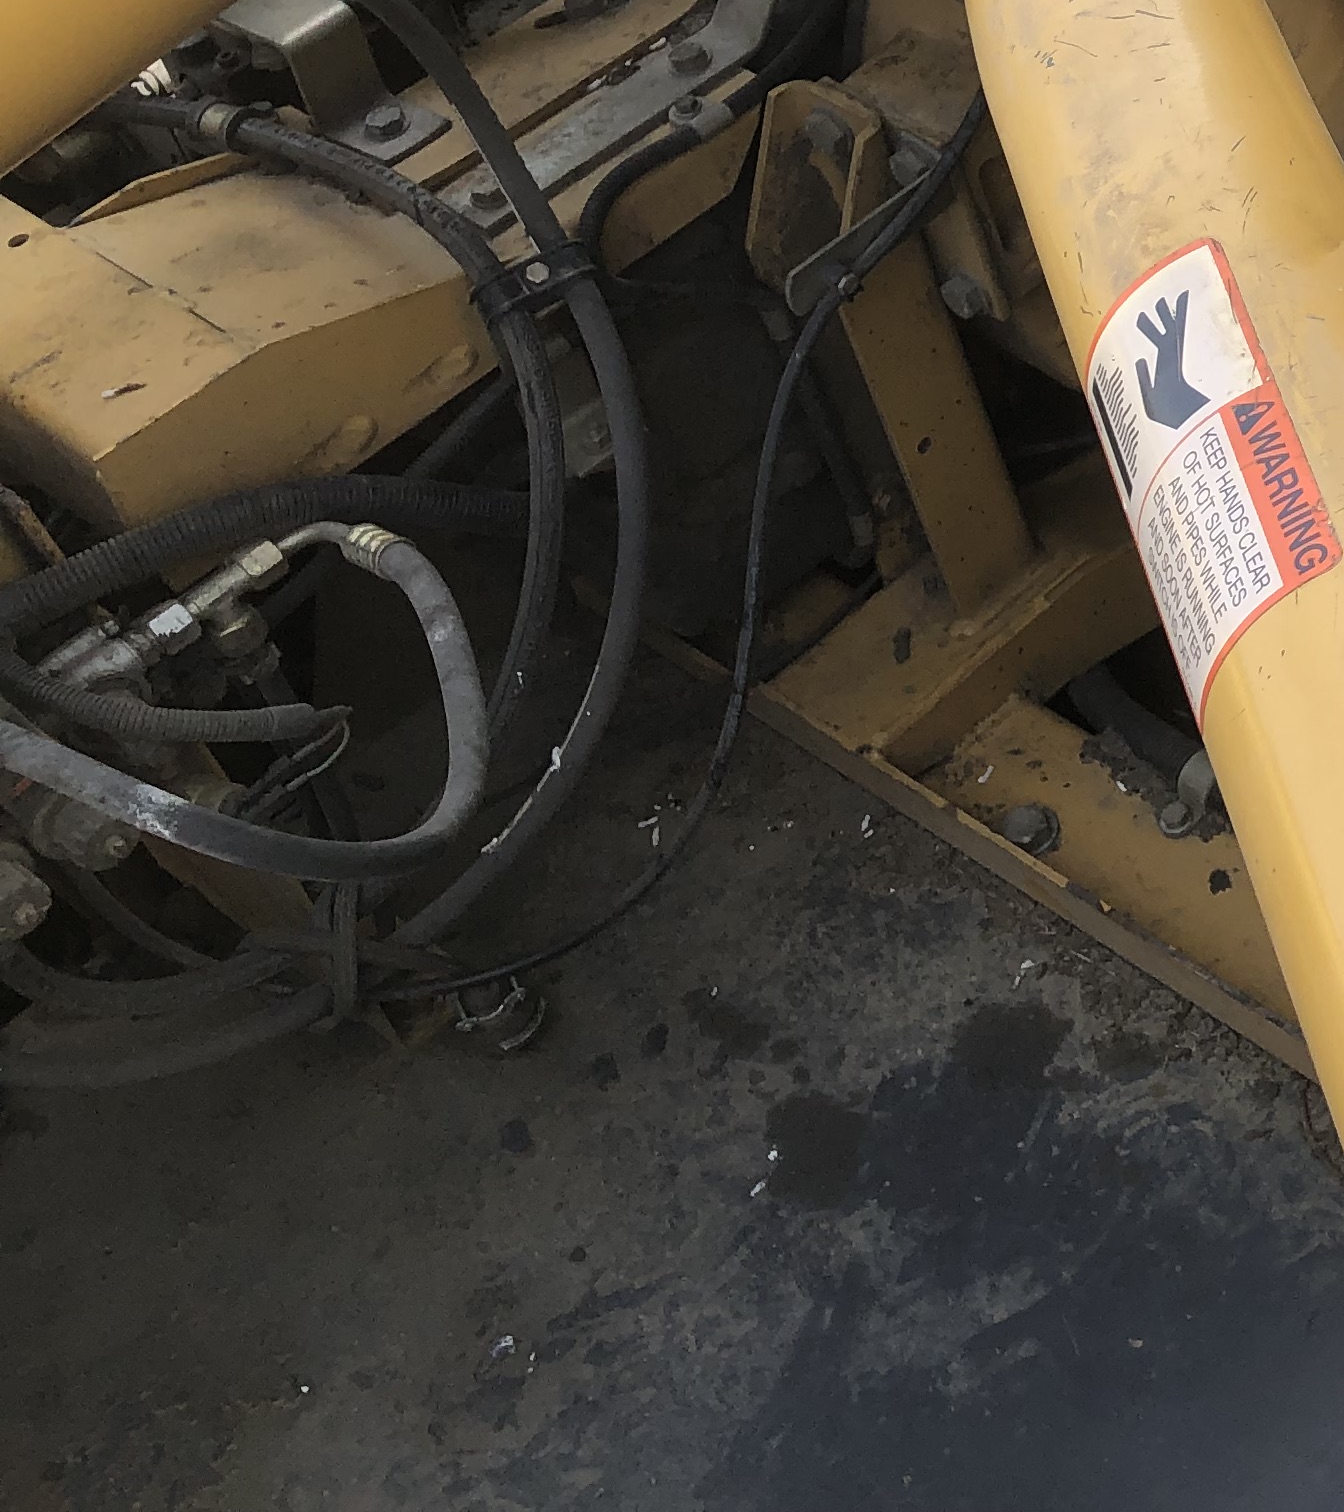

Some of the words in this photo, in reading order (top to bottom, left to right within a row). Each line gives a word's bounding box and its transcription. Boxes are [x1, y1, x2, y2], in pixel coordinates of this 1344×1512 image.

[1183, 450, 1202, 475] OF
[1190, 476, 1216, 514] HOT
[1200, 426, 1228, 471] KEEP
[1215, 469, 1250, 535] HANDS
[1238, 532, 1271, 594] CLEAR
[1247, 420, 1328, 576] WARNING
[1147, 517, 1164, 557] AND
[1161, 552, 1182, 611] SOON
[1178, 606, 1202, 668] AFTER
[1149, 544, 1172, 618] SWITCH
[1177, 634, 1192, 670] OFF
[1152, 484, 1182, 555] ENGINE
[1174, 548, 1187, 572] IS
[1181, 569, 1216, 656] RUNNING
[1168, 475, 1189, 516] AND
[1181, 511, 1207, 567] PIPES
[1200, 560, 1228, 624] WHILE
[1205, 511, 1248, 608] SURFACES
